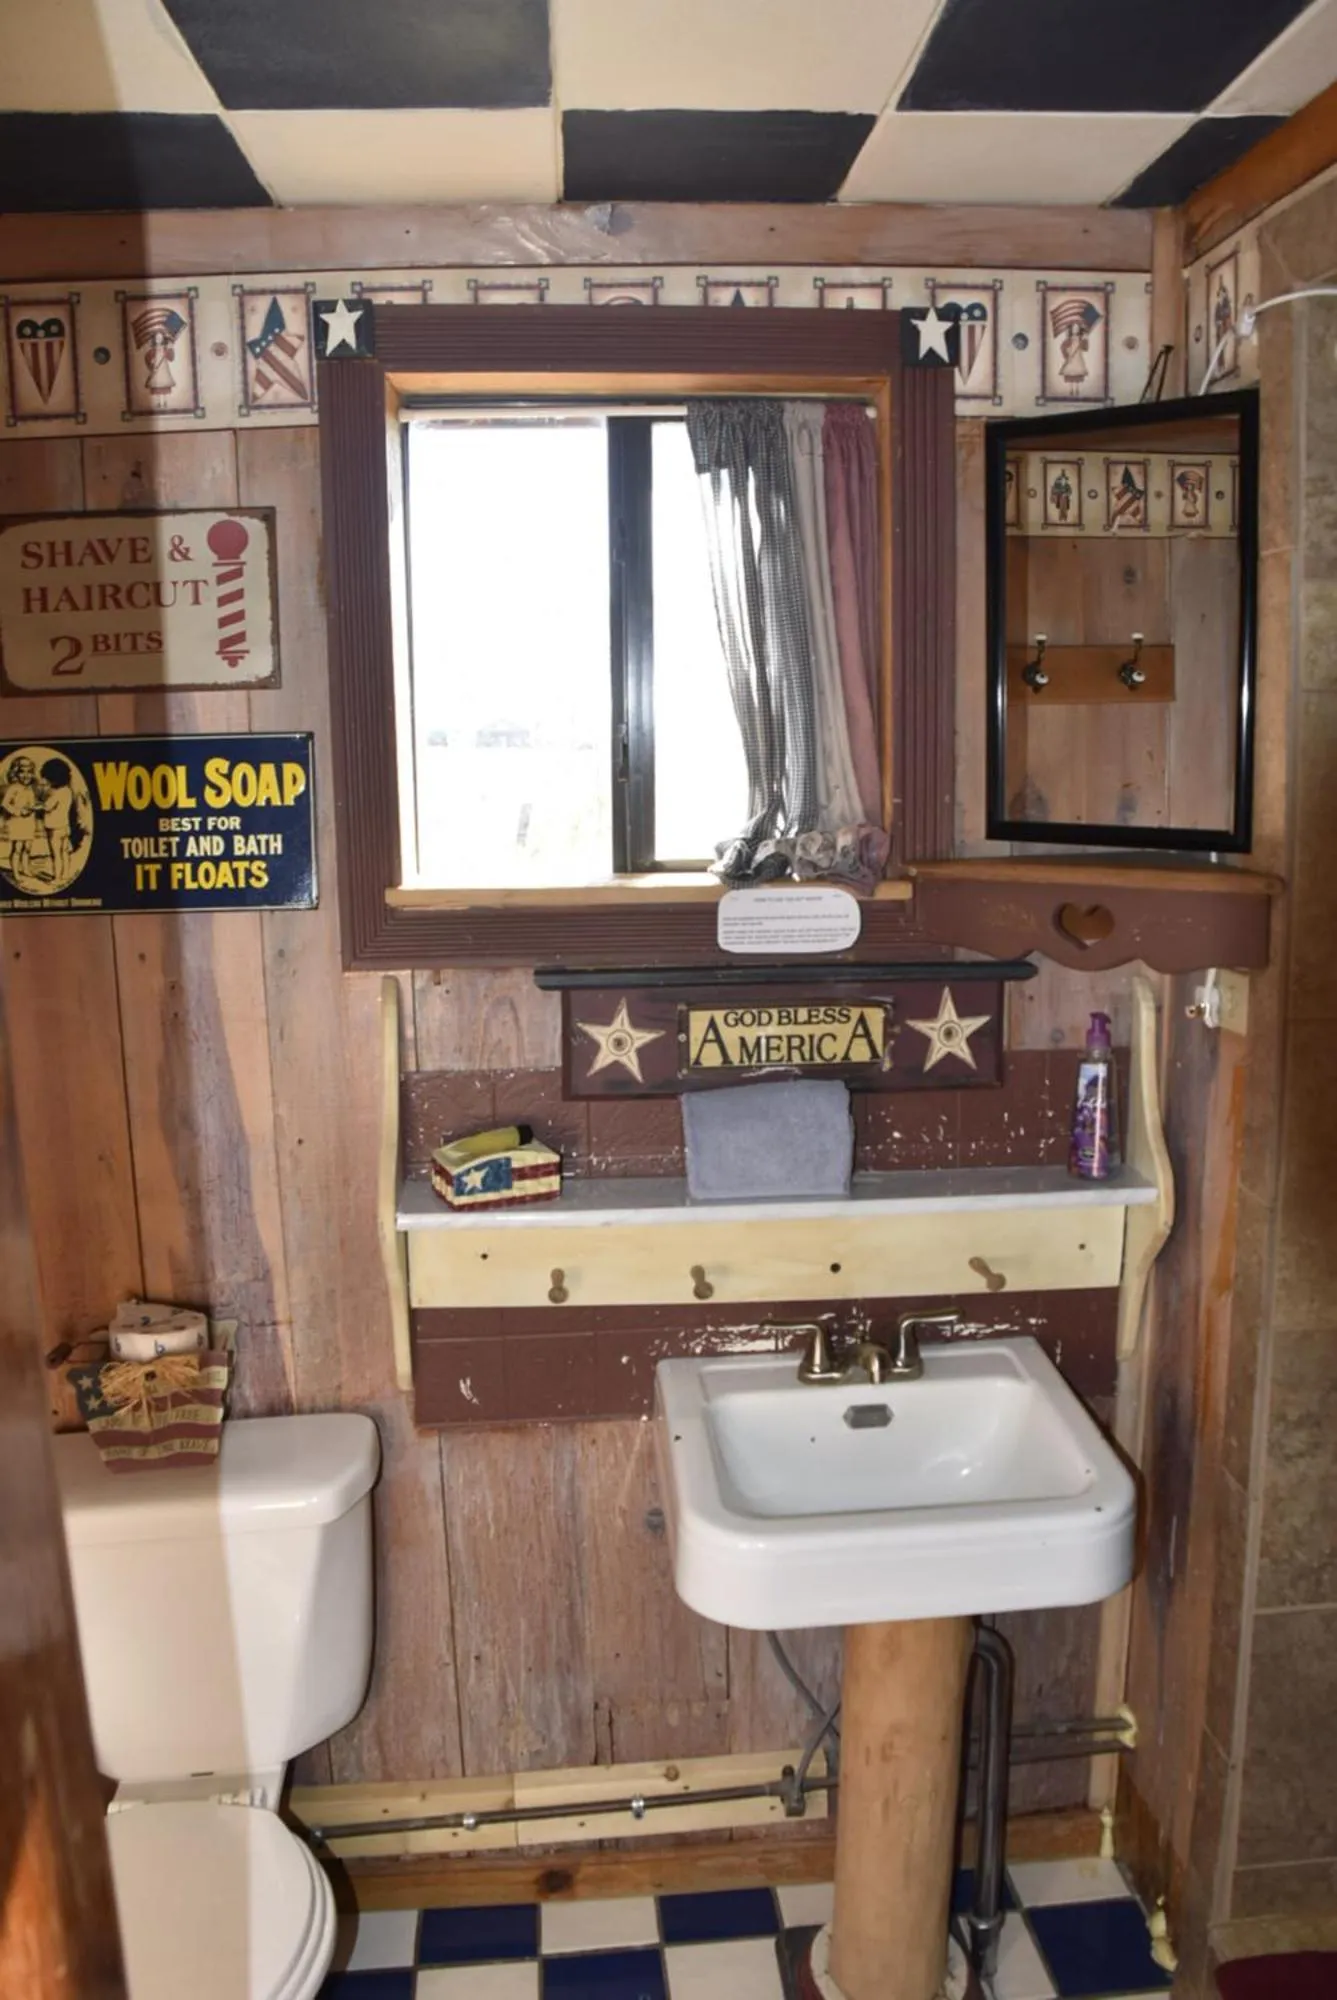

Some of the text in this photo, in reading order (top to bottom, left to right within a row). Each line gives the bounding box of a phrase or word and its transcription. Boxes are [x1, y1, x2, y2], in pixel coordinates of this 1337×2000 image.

[20, 534, 193, 570] SHAVE &
[22, 579, 209, 614] HAIRCUT
[49, 630, 163, 676] 2 BITS
[92, 757, 307, 811] WOOL SOAP
[158, 815, 241, 832] BEST FOR
[120, 833, 283, 859] TOILET AND BATH
[135, 860, 269, 891] IT FLOATS
[723, 1007, 852, 1028] GOD BLESS
[692, 1010, 882, 1066] AMERICA
